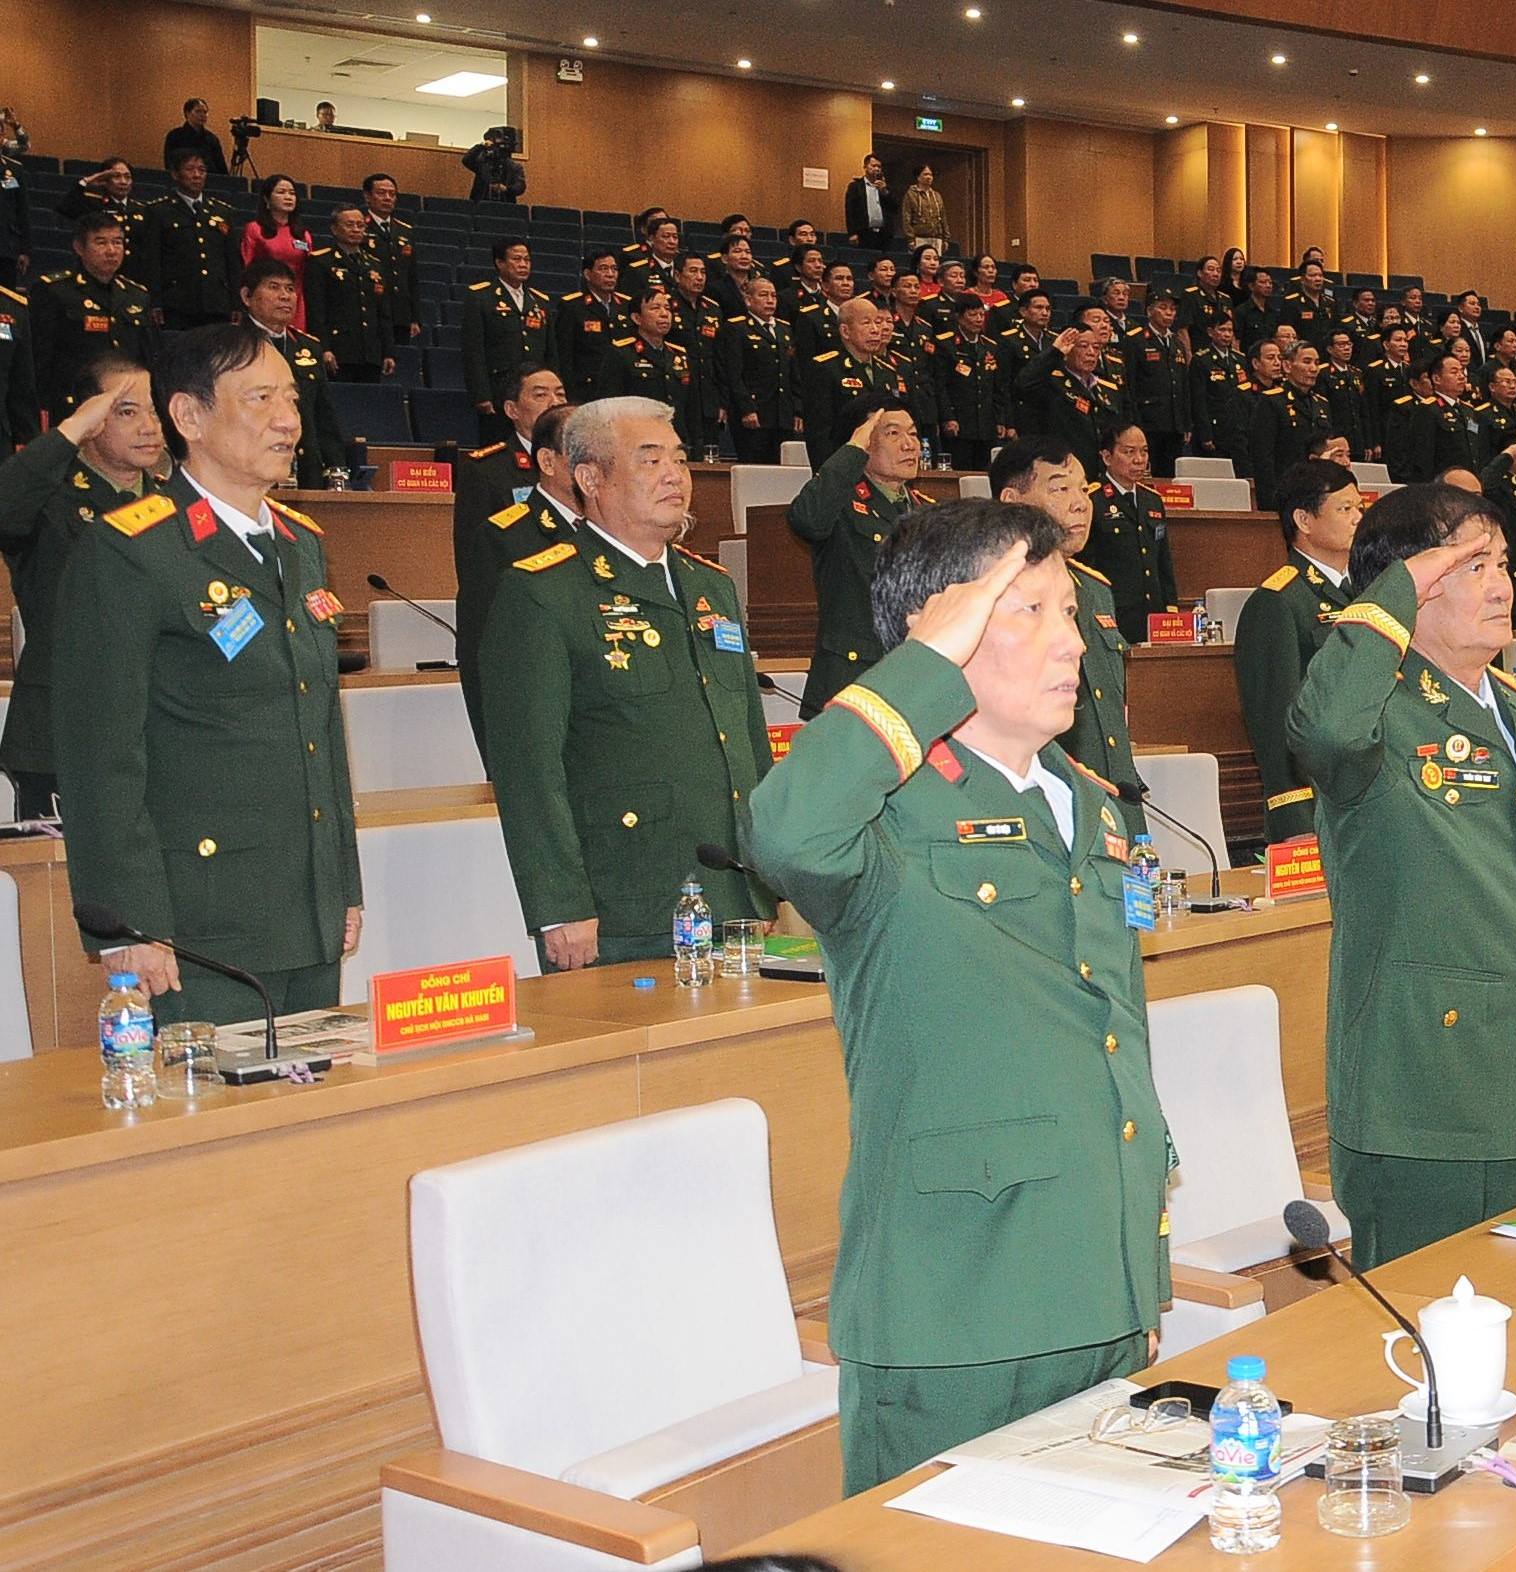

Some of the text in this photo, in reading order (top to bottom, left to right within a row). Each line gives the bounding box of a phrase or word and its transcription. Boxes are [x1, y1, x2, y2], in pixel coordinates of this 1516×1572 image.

[420, 971, 471, 989] ĐỒNG CHÍ
[386, 993, 433, 1021] NGUYỄN
[435, 991, 459, 1013] VĂN
[1215, 1445, 1255, 1465] aVie
